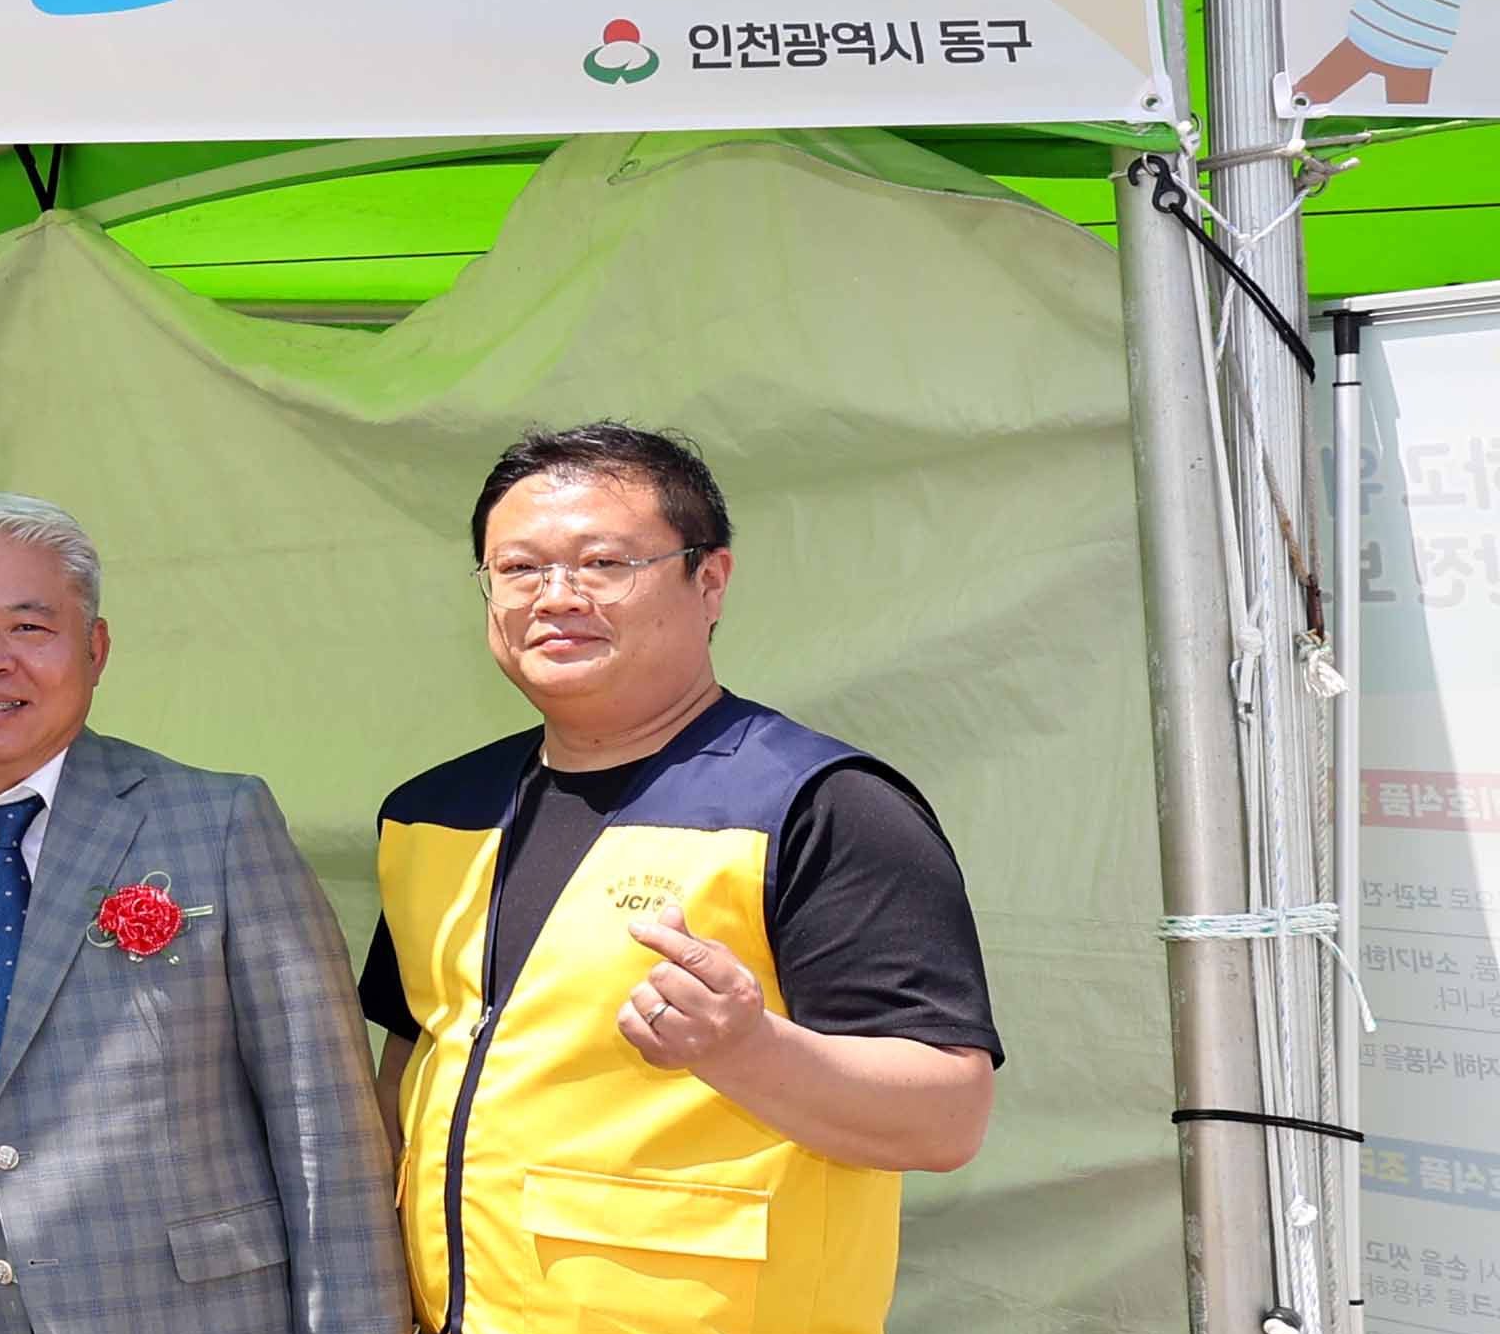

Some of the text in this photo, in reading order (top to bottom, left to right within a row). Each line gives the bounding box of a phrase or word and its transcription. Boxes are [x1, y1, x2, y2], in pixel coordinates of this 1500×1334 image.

[688, 19, 1034, 68] 인천광역시 동구
[615, 894, 652, 910] JCI
